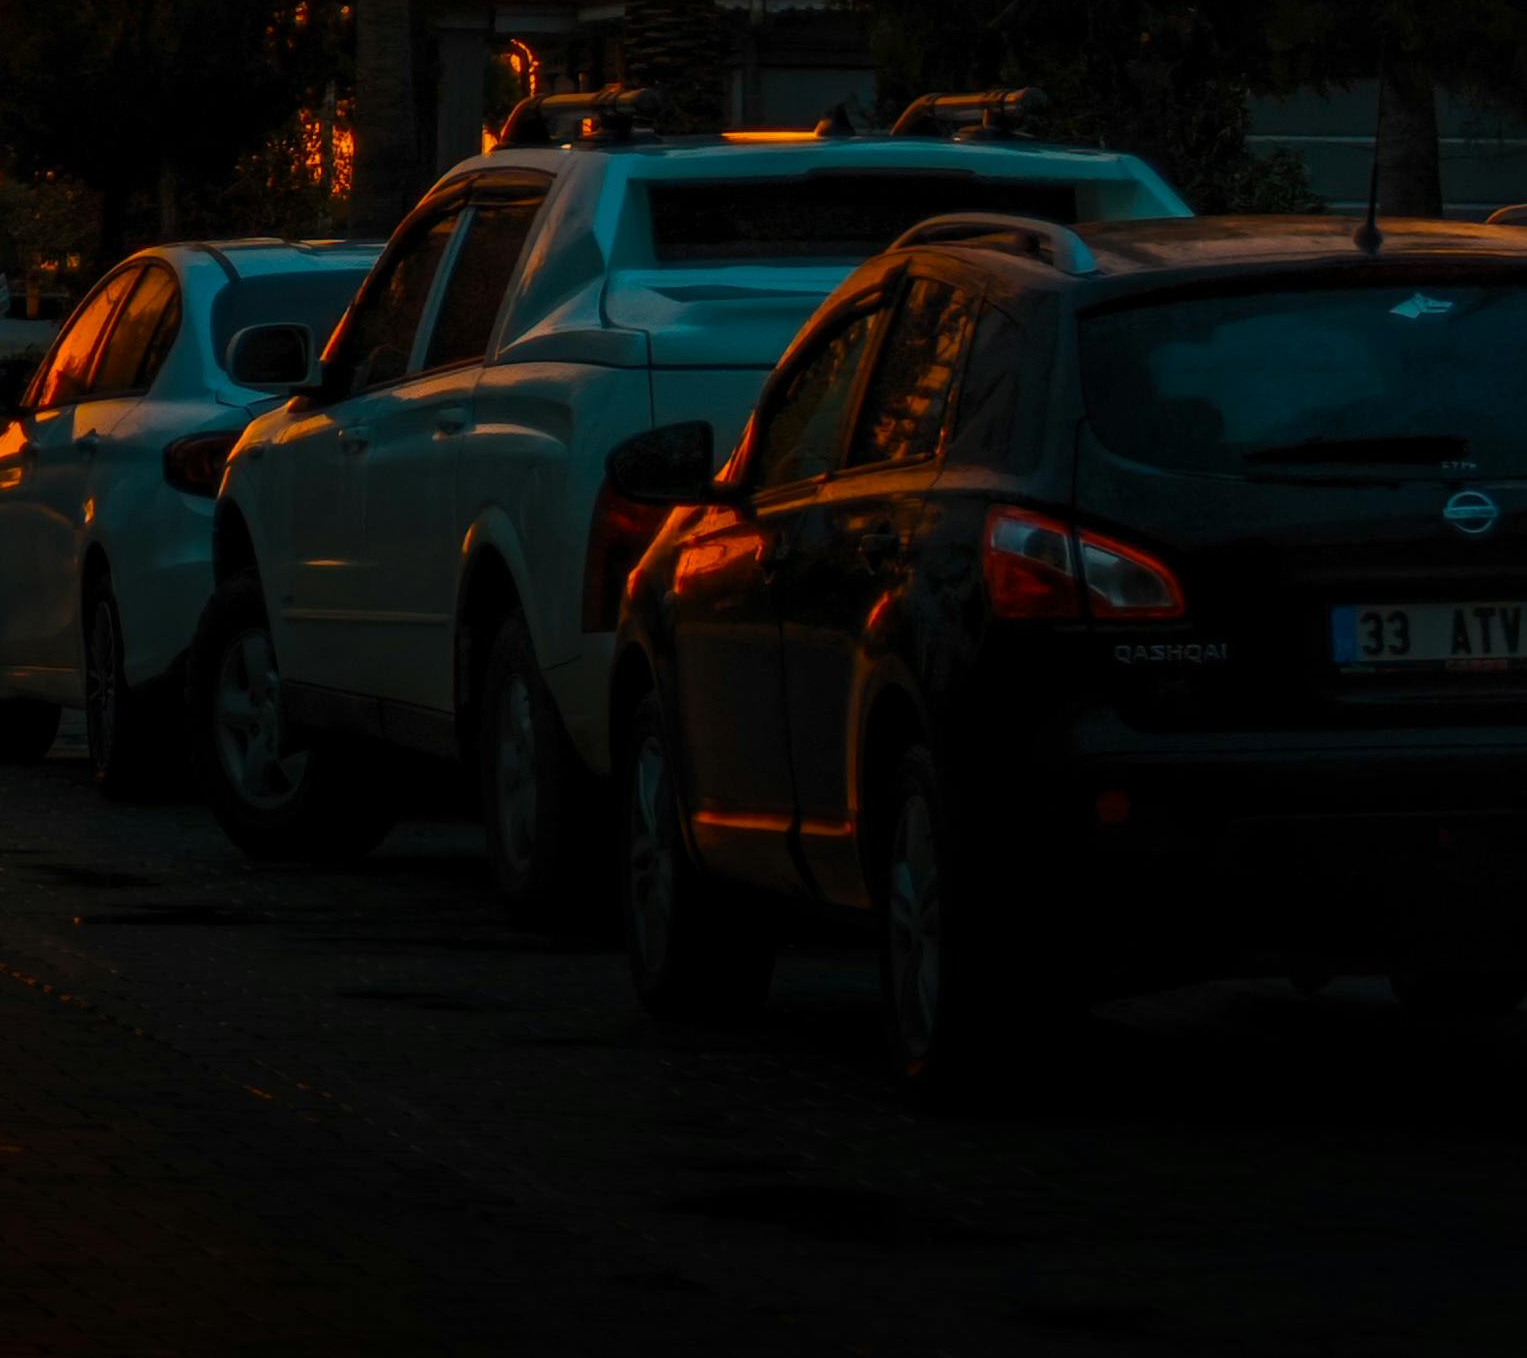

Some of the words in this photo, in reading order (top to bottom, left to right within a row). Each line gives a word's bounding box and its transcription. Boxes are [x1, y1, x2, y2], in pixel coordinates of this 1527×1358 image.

[1359, 611, 1411, 655] 33
[1450, 606, 1521, 654] ATV
[1113, 643, 1228, 665] QASHQAI
